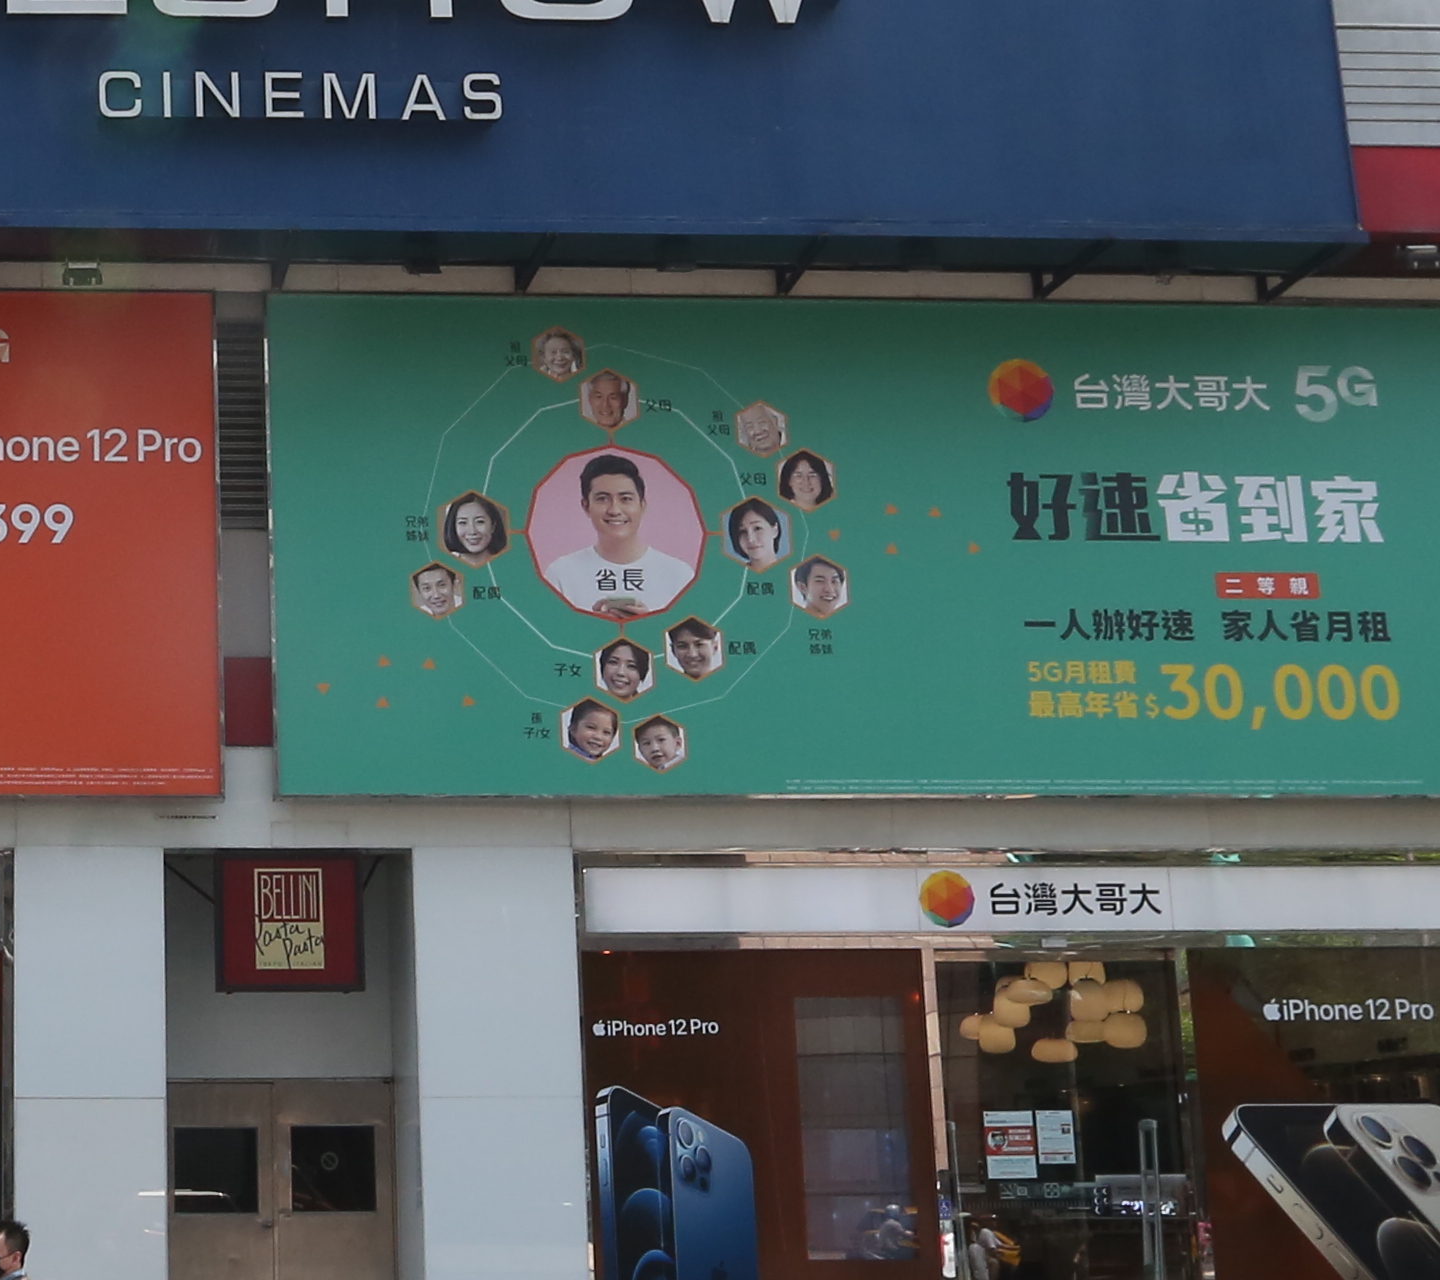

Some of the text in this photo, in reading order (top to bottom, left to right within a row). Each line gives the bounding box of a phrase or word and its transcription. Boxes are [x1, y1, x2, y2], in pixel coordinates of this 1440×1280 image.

[97, 69, 503, 122] CINEMAS
[645, 398, 673, 413] 父母
[1072, 365, 1380, 424] 台灣大哥大 5G
[85, 429, 129, 462] 12
[136, 427, 203, 464] Pro
[739, 472, 768, 488] 父母
[1006, 470, 1385, 544] 好速省到家
[472, 585, 502, 601] 配偶
[595, 568, 646, 593] 省長
[746, 580, 776, 596] 配偶
[1224, 576, 1310, 597] 二等親
[1023, 608, 1392, 645] 一人辦好速 家人省月租
[727, 640, 757, 656] 配偶
[554, 662, 582, 678] 子女
[1026, 660, 1137, 685] 5G月租費
[1027, 662, 1402, 731] 最高年省 $30,000
[260, 874, 317, 920] BELLINI
[989, 882, 1163, 917] 台灣大哥大
[255, 915, 306, 957] Pasta
[282, 927, 326, 969] Pasta
[1282, 997, 1435, 1023] iPhone 12 Pro
[606, 1019, 720, 1039] iPhone 12 Pro
